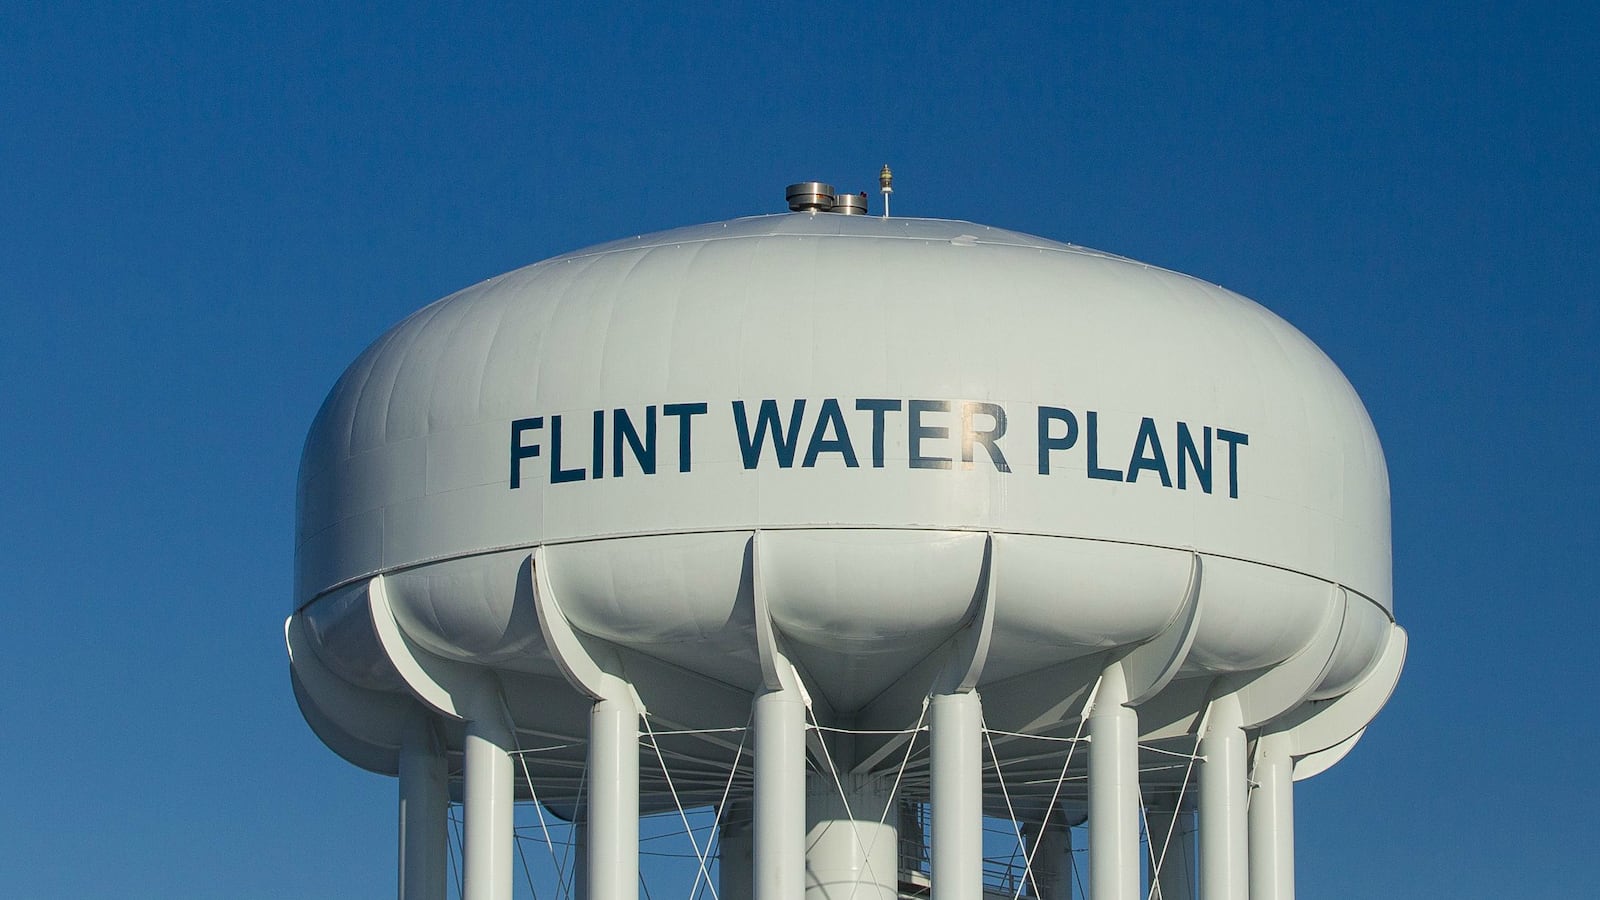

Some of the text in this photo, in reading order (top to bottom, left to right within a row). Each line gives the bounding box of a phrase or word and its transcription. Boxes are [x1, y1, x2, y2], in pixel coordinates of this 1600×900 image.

[510, 399, 1249, 500] FLINT WATER PLANT
